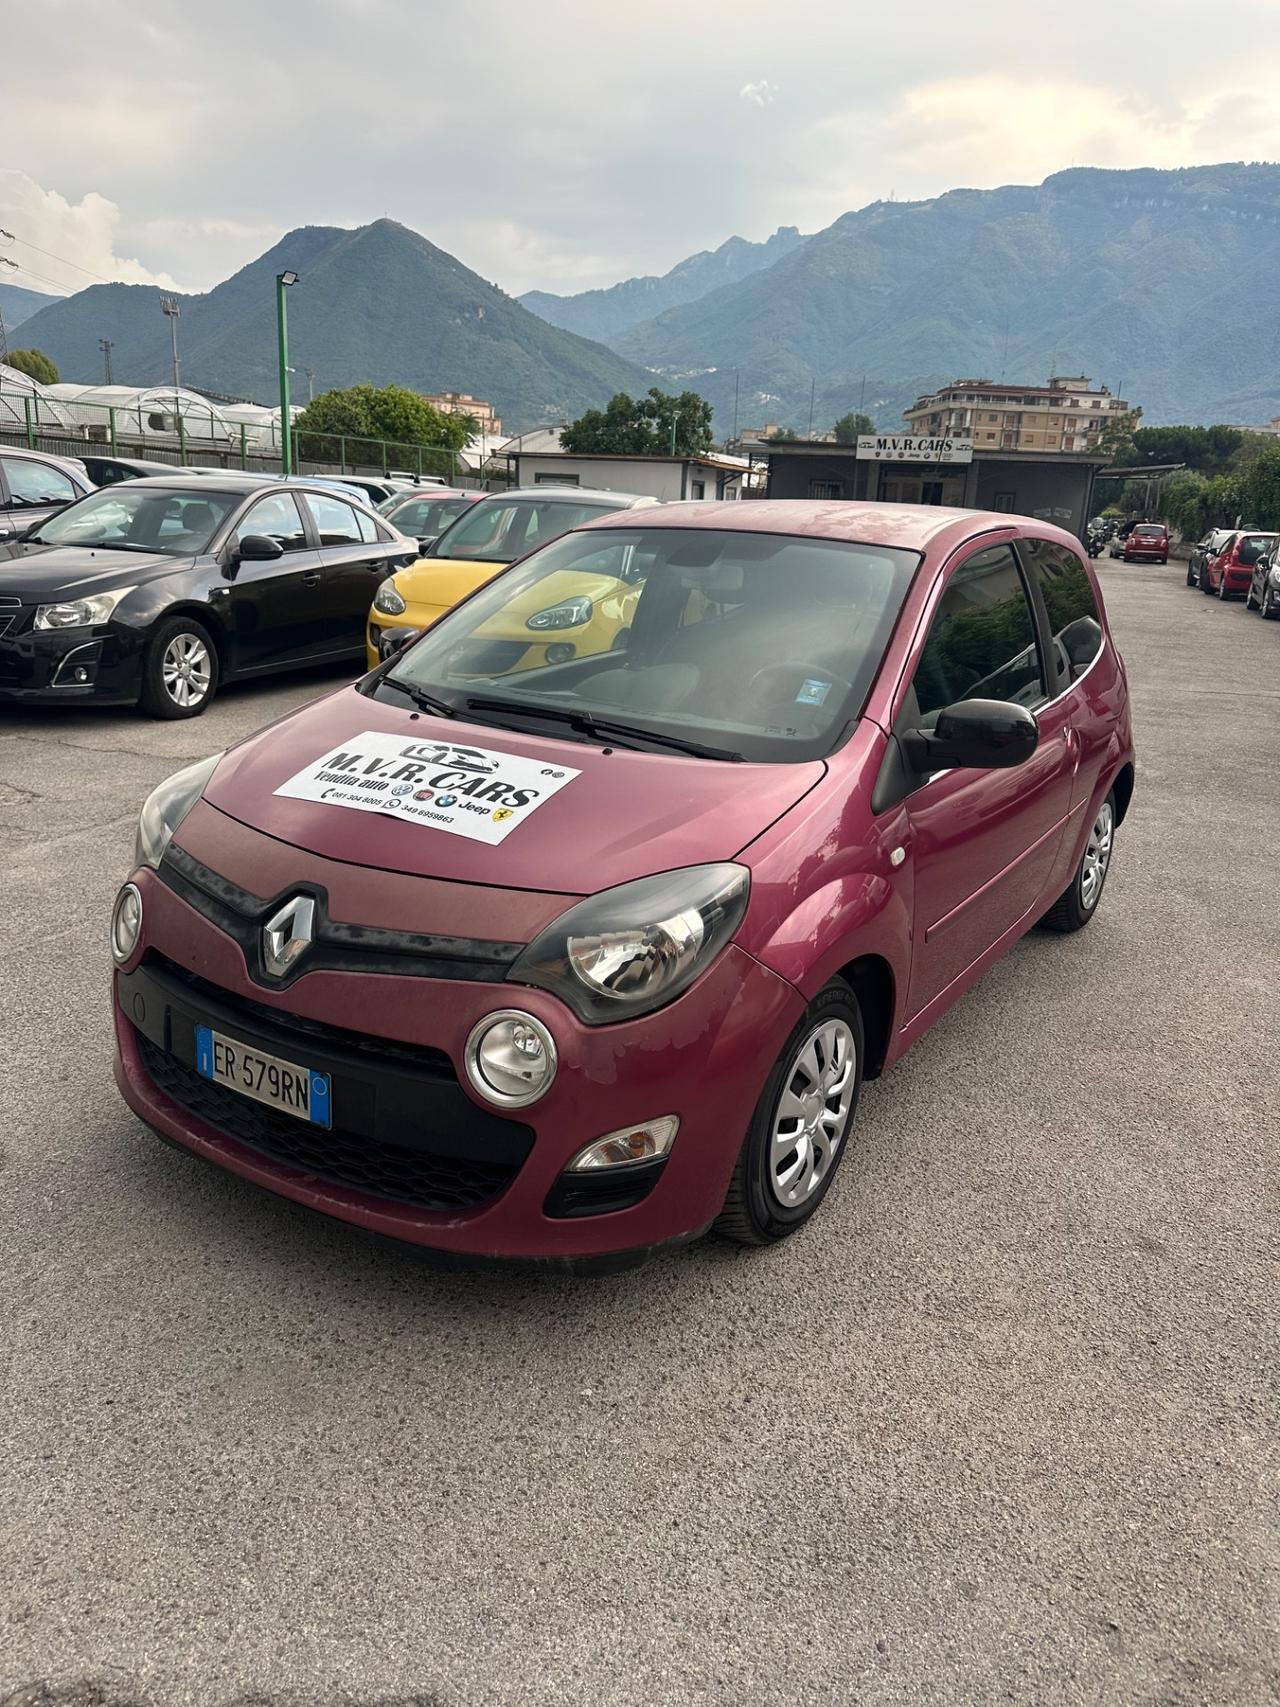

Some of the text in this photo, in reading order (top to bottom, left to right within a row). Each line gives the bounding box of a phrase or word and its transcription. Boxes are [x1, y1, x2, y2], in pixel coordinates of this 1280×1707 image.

[313, 771, 390, 792] Vendita auto
[400, 804, 454, 823] 349 6959863
[458, 801, 491, 816] Jeep
[213, 1041, 236, 1081] ER
